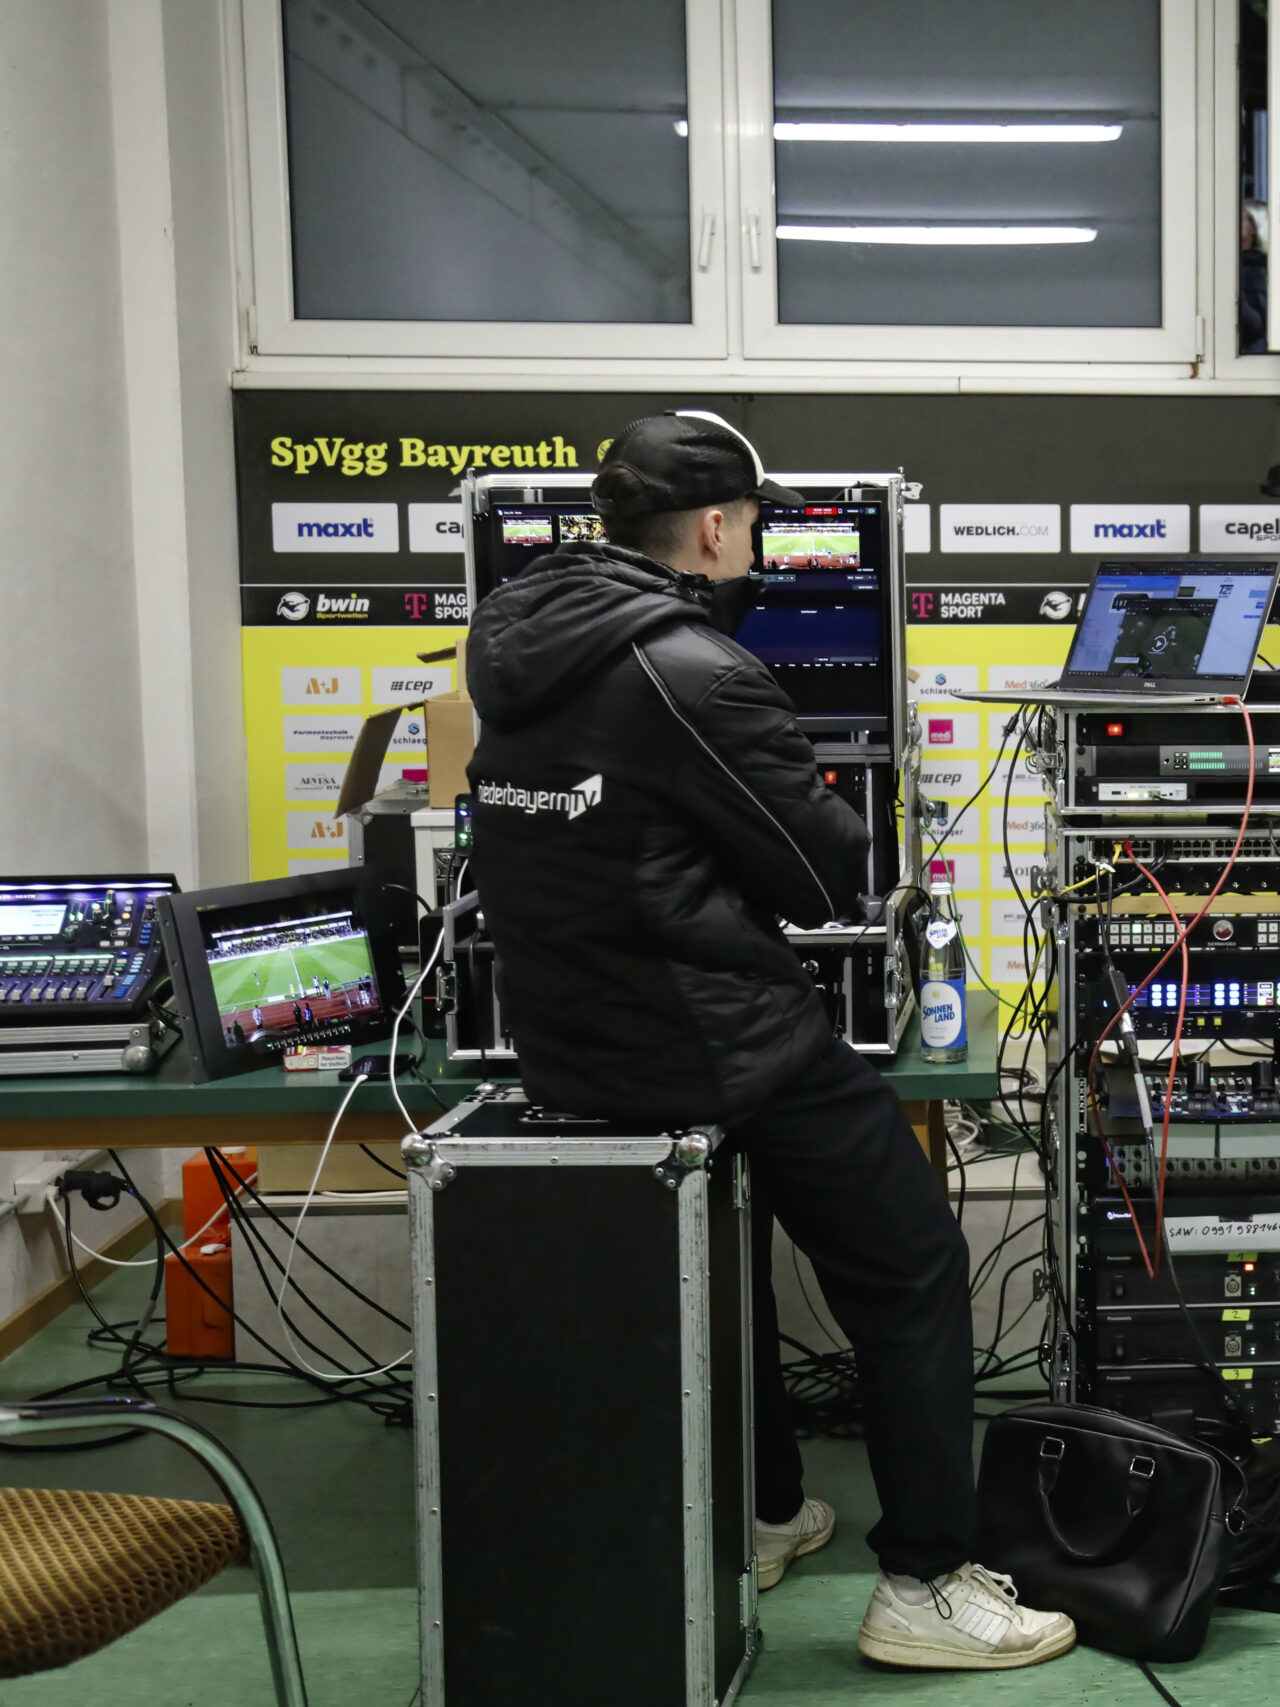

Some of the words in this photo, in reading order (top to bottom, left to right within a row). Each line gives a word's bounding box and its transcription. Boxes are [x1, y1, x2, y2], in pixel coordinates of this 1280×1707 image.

[270, 436, 388, 476] SpVgg
[399, 436, 579, 475] Bayreuth
[297, 518, 374, 538] maxit
[953, 525, 1048, 537] WEDLICH.COM
[1094, 519, 1166, 538] maxit
[316, 593, 370, 612] bwin
[940, 593, 1006, 606] MAGENTA
[940, 606, 984, 619] SPORT
[405, 680, 433, 693] cep
[934, 773, 962, 787] cep
[922, 1003, 953, 1020] SONNEN
[934, 1011, 955, 1023] LAND
[1232, 1310, 1241, 1319] 2
[1233, 1369, 1240, 1380] 3
